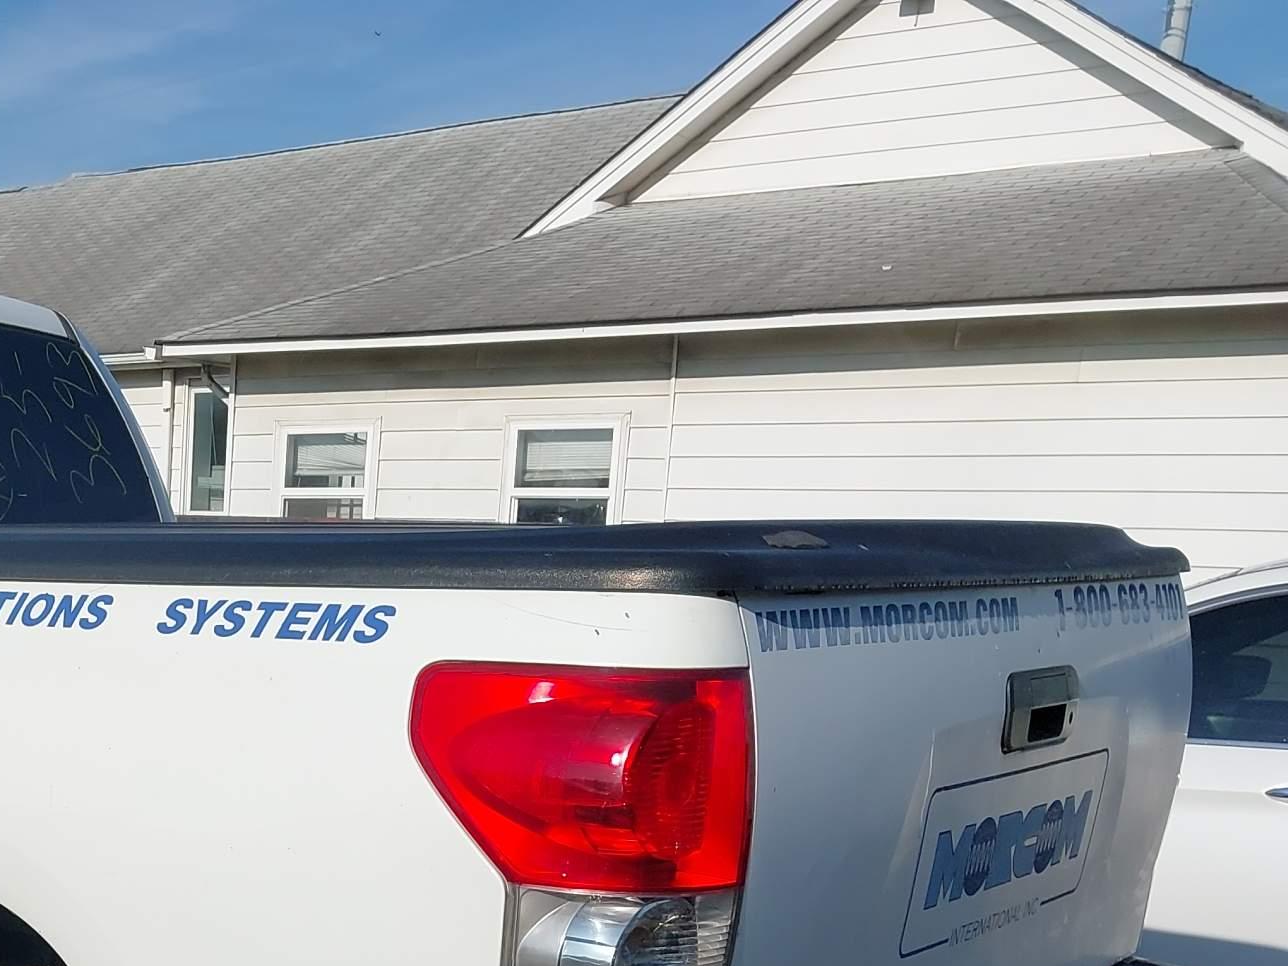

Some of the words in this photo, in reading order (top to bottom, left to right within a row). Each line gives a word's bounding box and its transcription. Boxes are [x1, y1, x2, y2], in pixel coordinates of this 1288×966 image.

[45, 341, 128, 504] 3693
[156, 599, 397, 644] SYSTEMS
[755, 597, 1020, 654] WWW.MORCOM.COM
[1054, 582, 1185, 633] 1-800-683-4101
[923, 789, 1093, 910] MORCOM
[949, 904, 1021, 947] INTERNATIONAL
